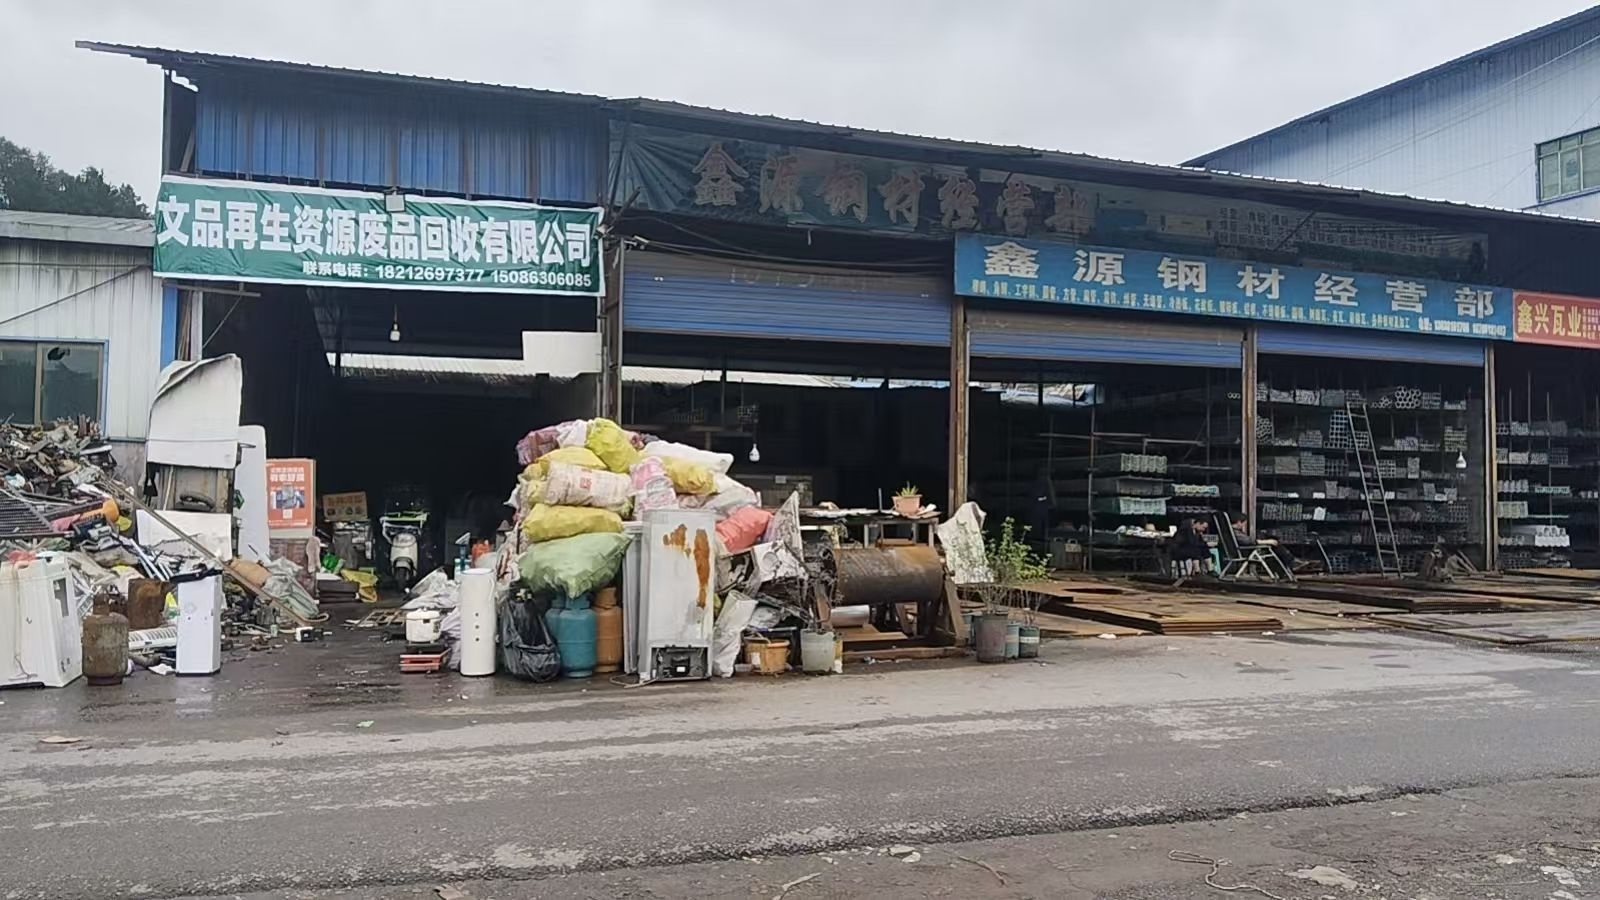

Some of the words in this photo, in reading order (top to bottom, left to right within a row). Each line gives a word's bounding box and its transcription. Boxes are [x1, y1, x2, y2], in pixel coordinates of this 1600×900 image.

[157, 196, 591, 267] 文品再生资源废品回收有限公司
[375, 265, 484, 282] 18212697377
[491, 269, 592, 287] 15086306085
[984, 241, 1494, 319] 鑫源钢材经营部
[1517, 299, 1582, 337] 鑫兴瓦业
